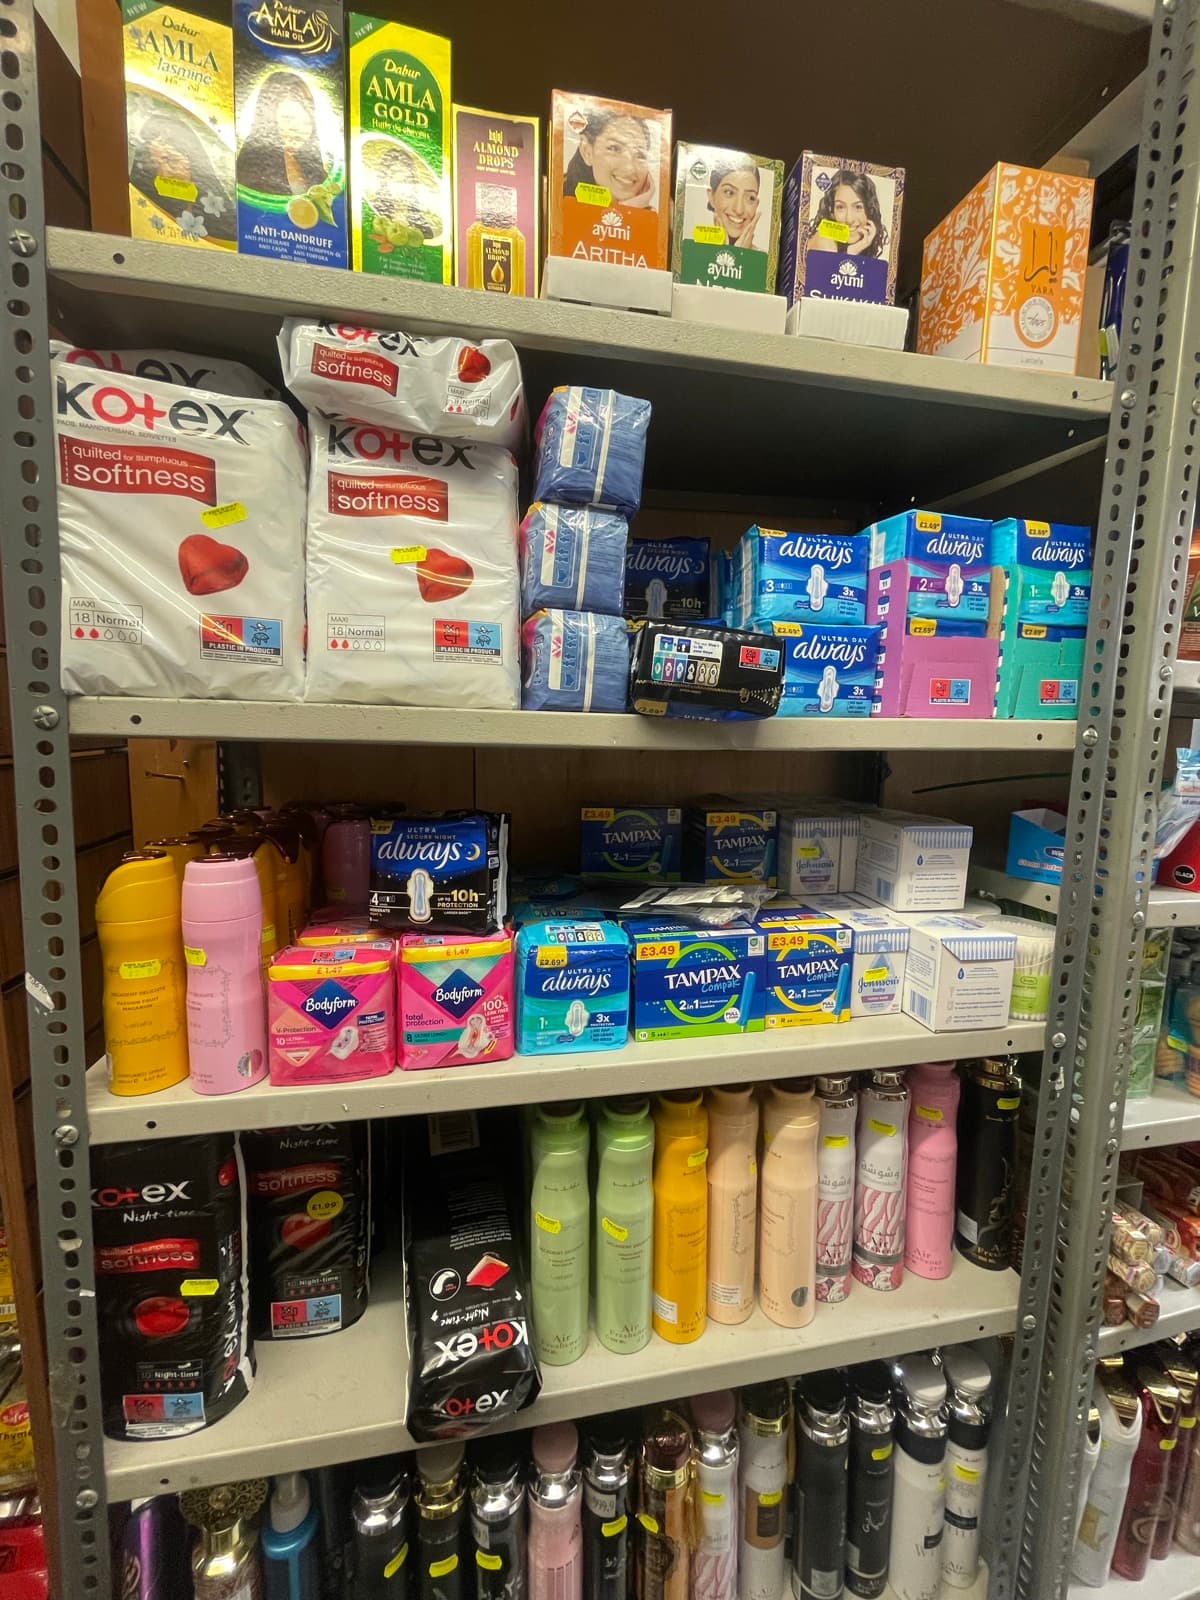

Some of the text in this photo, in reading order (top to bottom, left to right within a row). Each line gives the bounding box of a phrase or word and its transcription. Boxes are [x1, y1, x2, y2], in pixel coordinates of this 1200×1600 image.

[127, 4, 147, 16] NEW
[162, 15, 200, 37] Dabur
[256, 2, 317, 38] AMLA
[271, 27, 304, 43] HAIR OIL
[355, 22, 373, 38] NEW
[145, 29, 219, 73] AMLA
[157, 57, 212, 85] Jasmine
[384, 58, 421, 79] Dabur
[366, 75, 436, 112] AMLA
[374, 102, 429, 129] GOLD
[473, 141, 519, 159] ALMOND
[479, 155, 515, 170] DROPS
[253, 225, 333, 248] ANTI-DANDRUFF
[592, 223, 631, 242] ayumi
[572, 240, 649, 269] ARITHA
[707, 261, 742, 280] ayumi
[830, 270, 864, 289] ayumi
[318, 360, 392, 386] softness
[72, 445, 122, 460] quilted
[136, 454, 189, 468] sumptuous
[73, 463, 206, 493] softness
[337, 479, 375, 491] quilted
[337, 491, 440, 513] softness
[837, 538, 853, 546] DAY
[948, 533, 969, 541] ULTRA
[779, 536, 853, 569] always
[927, 532, 985, 565] always
[1031, 540, 1086, 569] always
[625, 547, 693, 580] always
[766, 580, 775, 592] 3
[843, 586, 854, 597] 3x
[920, 578, 927, 591] 2
[972, 582, 983, 592] 3x
[1074, 586, 1085, 597] 3x
[72, 600, 96, 609] MAXI
[681, 597, 701, 608] 10h
[75, 611, 143, 630] 18 Normal
[331, 615, 348, 624] MAXI
[331, 627, 383, 637] 18 Normal
[822, 635, 848, 643] ULTRA
[209, 642, 236, 651] PLASTIC
[245, 645, 275, 655] PRODUCT
[441, 646, 465, 654] PLASTIC
[793, 634, 867, 669] always
[852, 686, 864, 696] 3x
[408, 826, 436, 834] ULTRA
[602, 829, 663, 845] TAMPAX
[714, 835, 767, 850] TAMPAX
[377, 833, 463, 870] always
[1175, 870, 1194, 879] BLACK
[371, 892, 379, 906] 4
[451, 889, 479, 903] 10h
[771, 935, 804, 947] £3.49
[640, 946, 675, 958] £3.49
[777, 958, 839, 979] TAMPAX
[542, 968, 611, 996] always
[664, 964, 741, 990] TAMPAX
[806, 970, 839, 983] Compak
[701, 979, 741, 993] Compak
[435, 986, 483, 1004] Bodyform
[305, 996, 356, 1015] Bodyform
[405, 1018, 444, 1028] protection
[539, 1017, 545, 1030] 1
[596, 1014, 610, 1023] 3x
[276, 1026, 317, 1034] V-Protection
[276, 1037, 286, 1046] 10
[258, 1170, 337, 1192] softness
[312, 1201, 337, 1211] £1.99
[123, 1209, 196, 1224] Night-time
[102, 1251, 194, 1270] softness
[299, 1275, 339, 1287] Night-time
[622, 1324, 638, 1333] Air
[154, 1371, 200, 1379] Night-time
